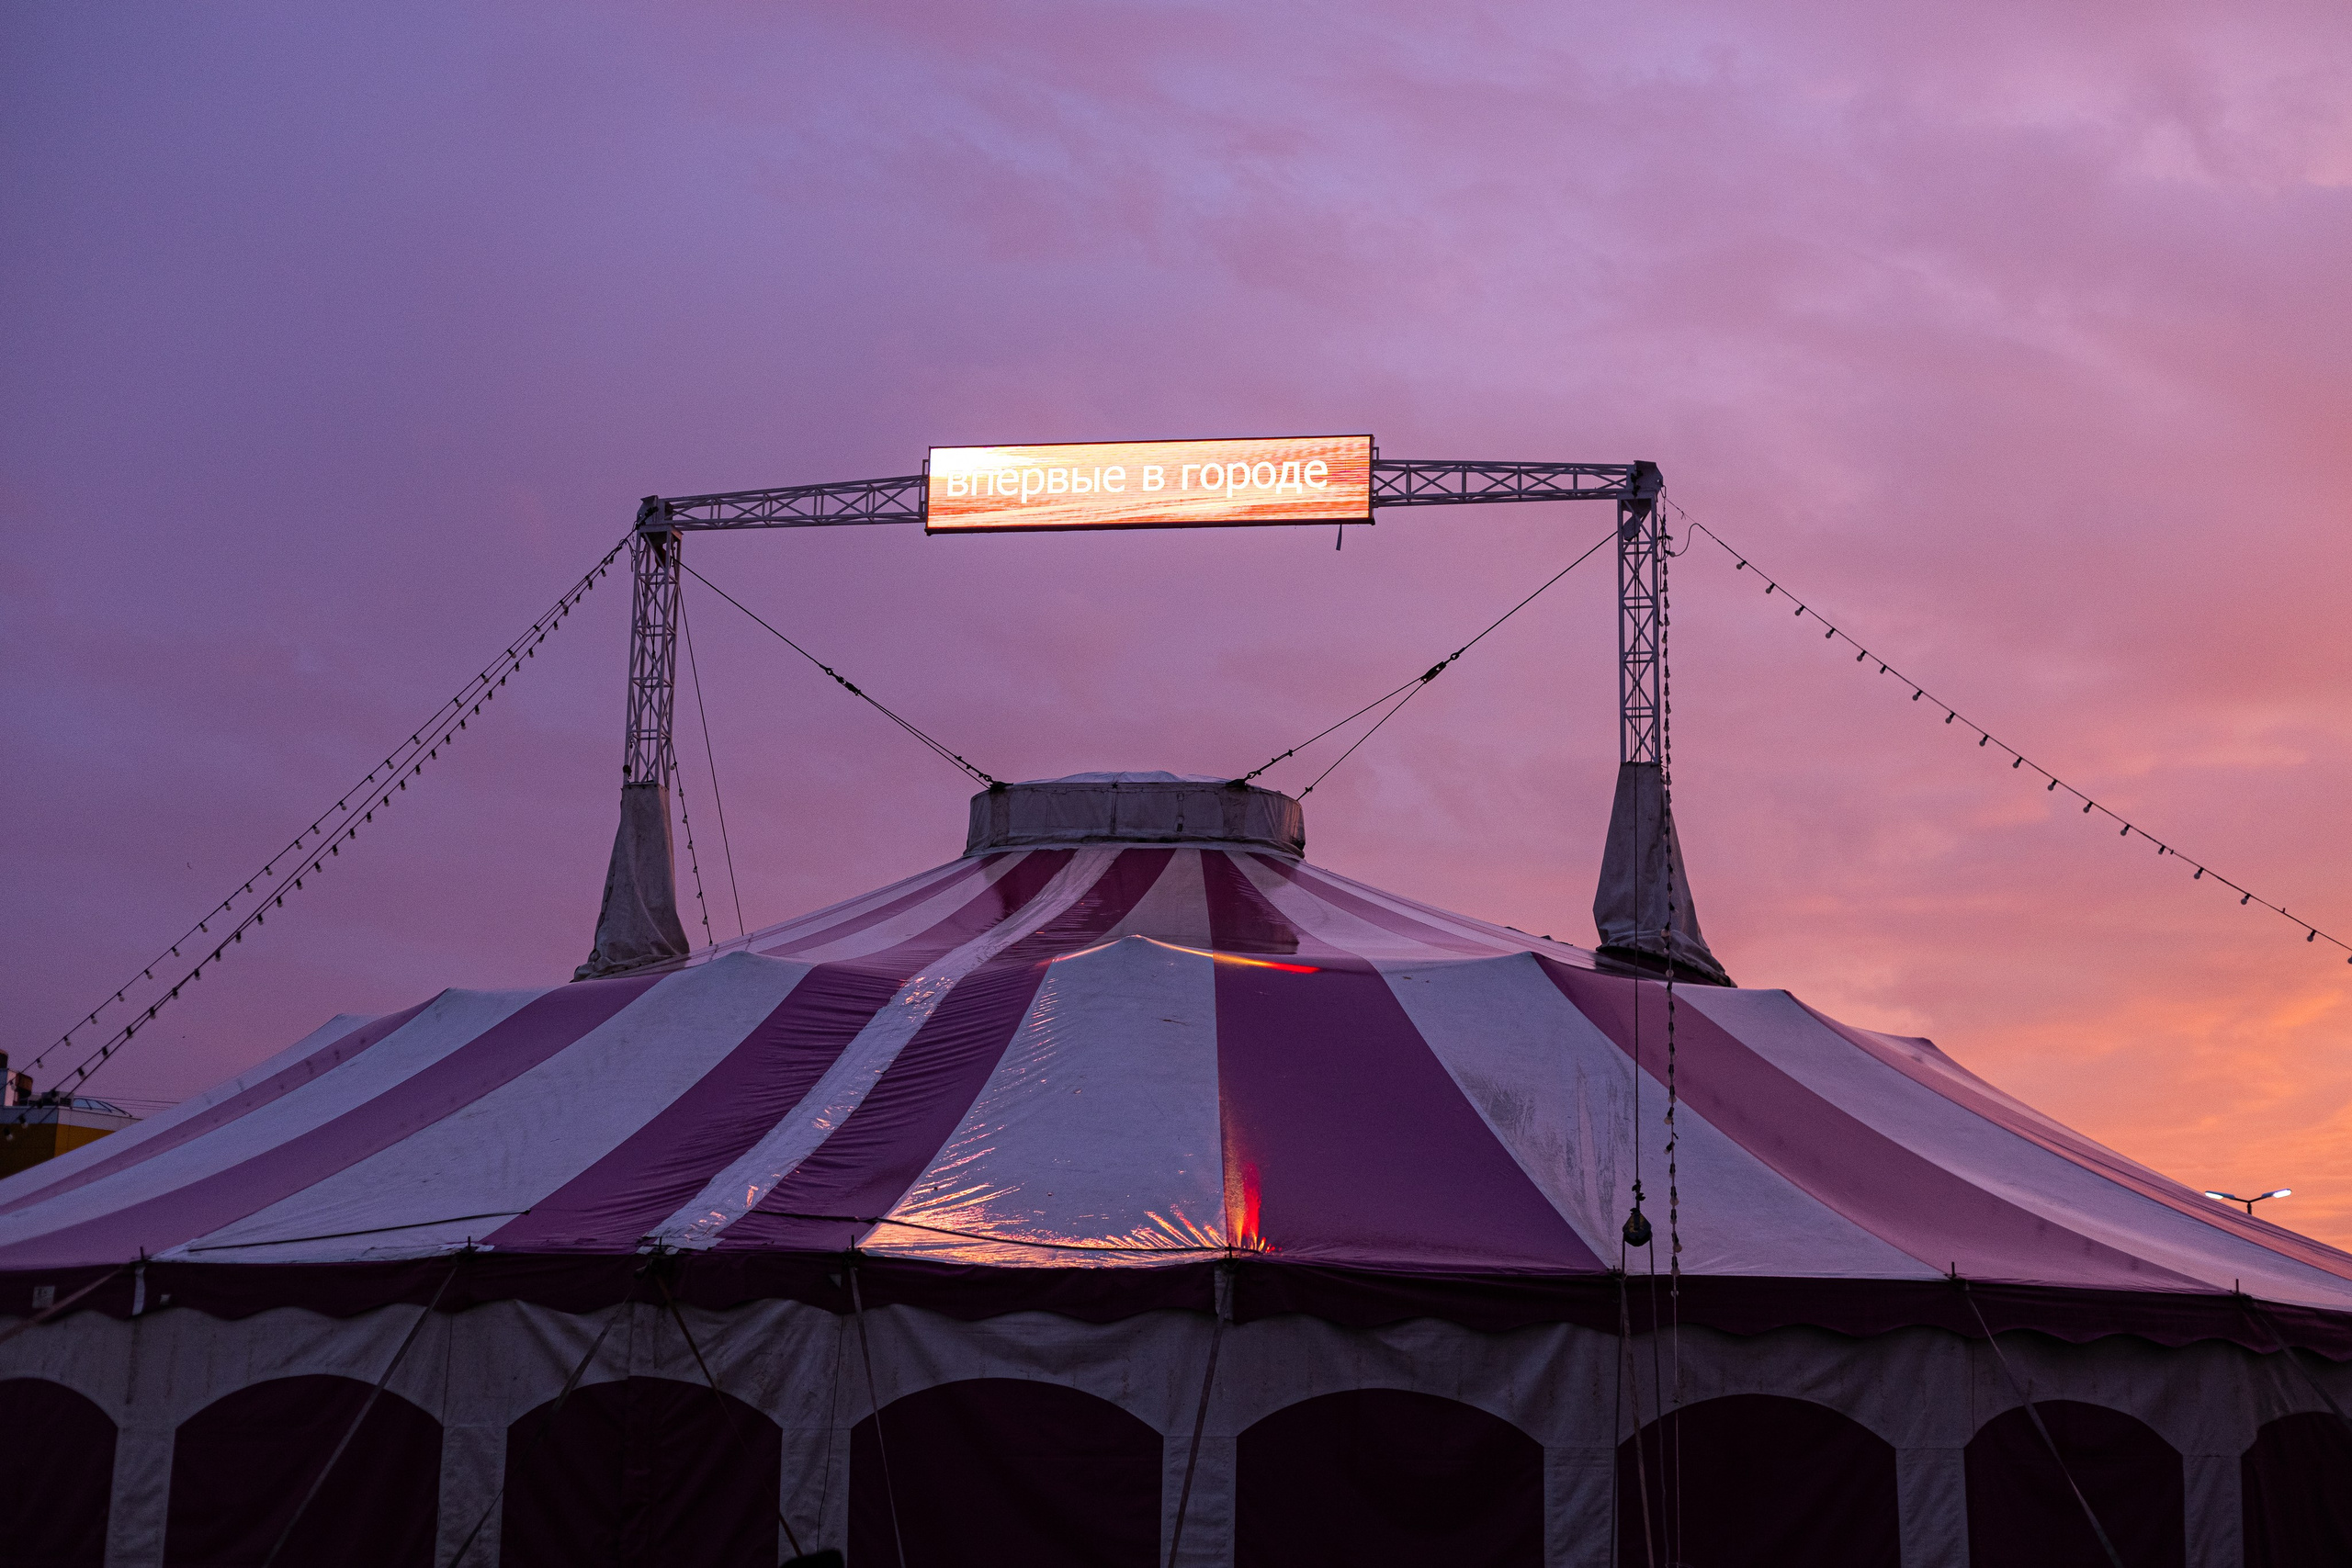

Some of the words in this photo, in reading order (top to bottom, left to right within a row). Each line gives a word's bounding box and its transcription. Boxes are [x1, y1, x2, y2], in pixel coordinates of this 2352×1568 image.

[946, 465, 1126, 503] впервые
[1142, 465, 1165, 491] в
[1182, 459, 1329, 498] городе
